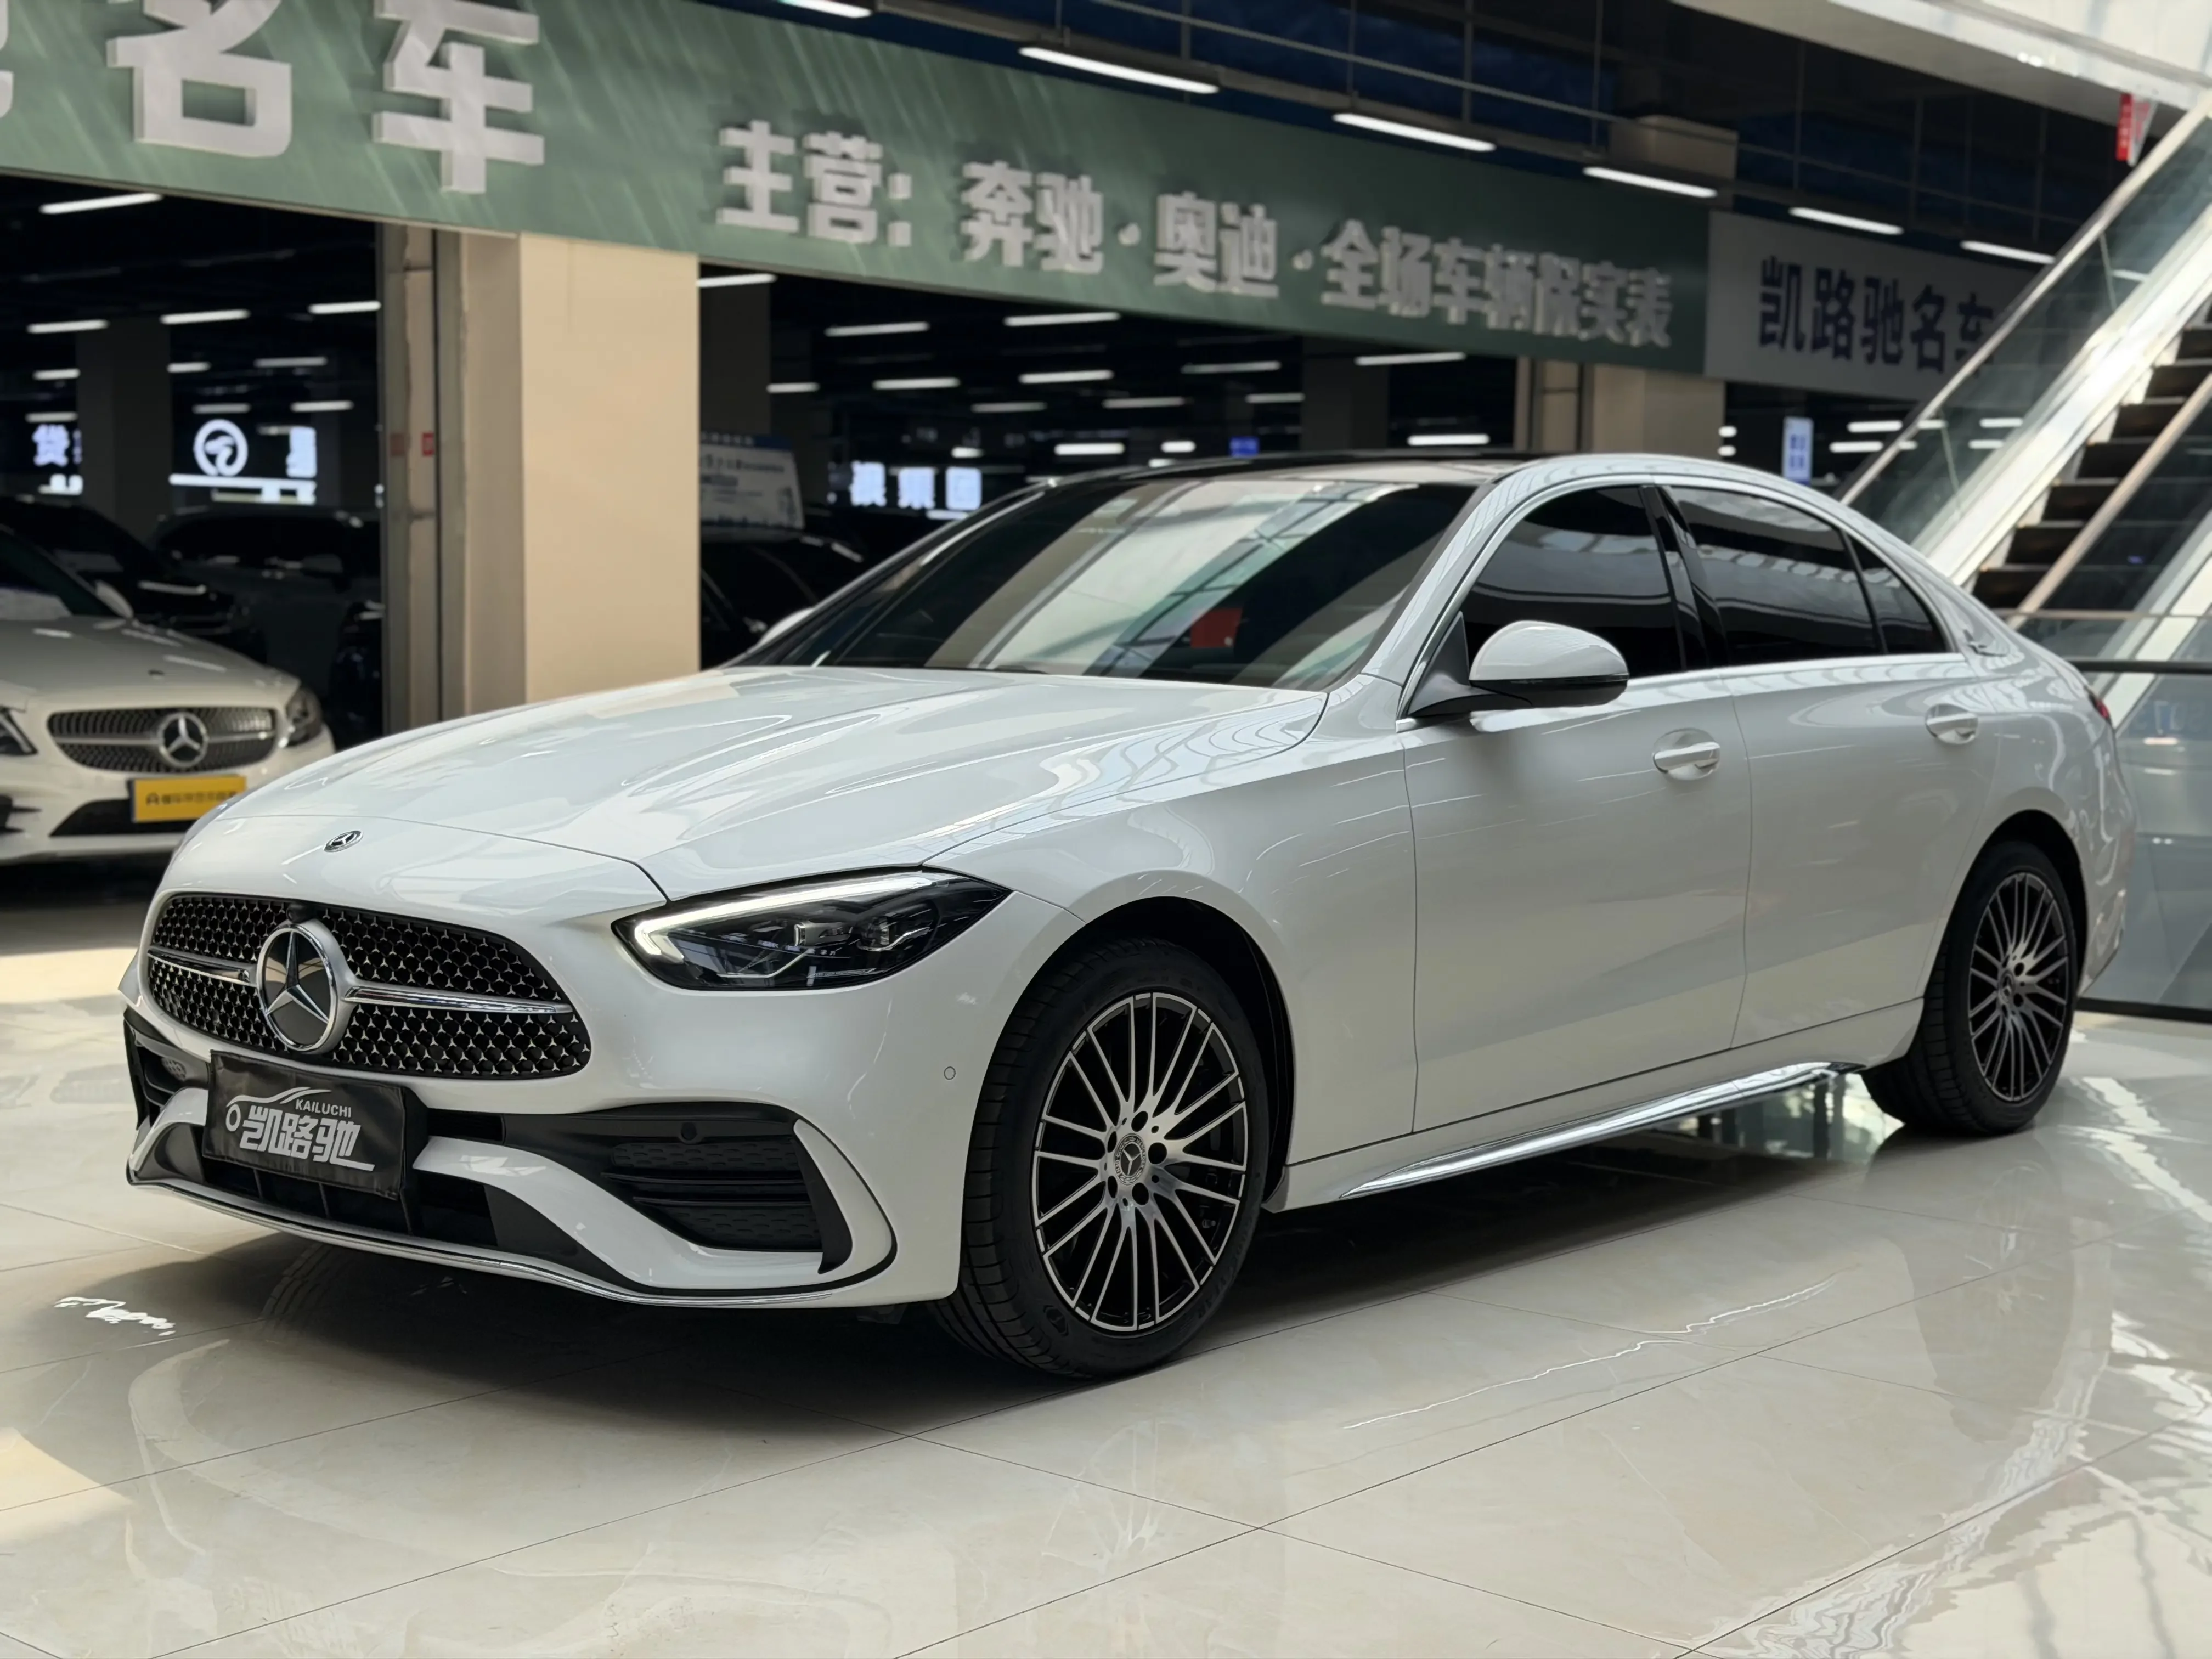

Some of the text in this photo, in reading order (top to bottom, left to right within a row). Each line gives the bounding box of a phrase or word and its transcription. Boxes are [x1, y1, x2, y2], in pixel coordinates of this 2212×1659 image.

[0, 0, 545, 193] 名车
[239, 1105, 375, 1172] 凯路驰
[295, 1098, 352, 1118] KAILUCHI
